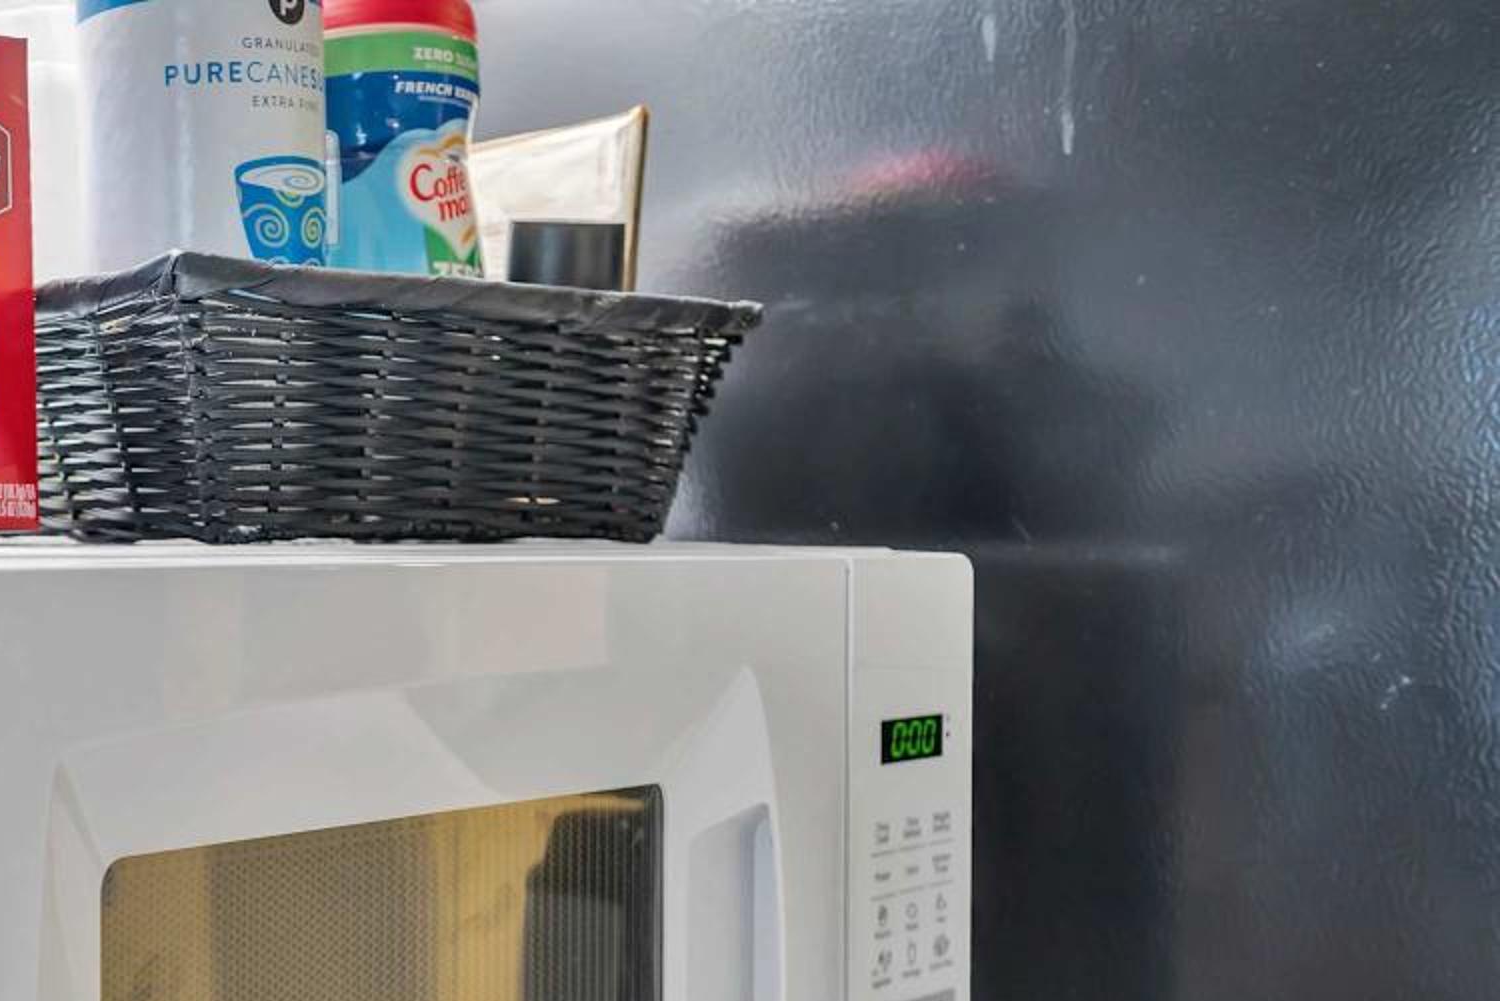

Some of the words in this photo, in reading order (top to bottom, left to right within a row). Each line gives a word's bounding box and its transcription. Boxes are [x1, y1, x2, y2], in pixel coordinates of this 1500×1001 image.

[413, 47, 454, 62] ZERO
[395, 81, 453, 96] FRENCH
[252, 95, 295, 108] EXTRA
